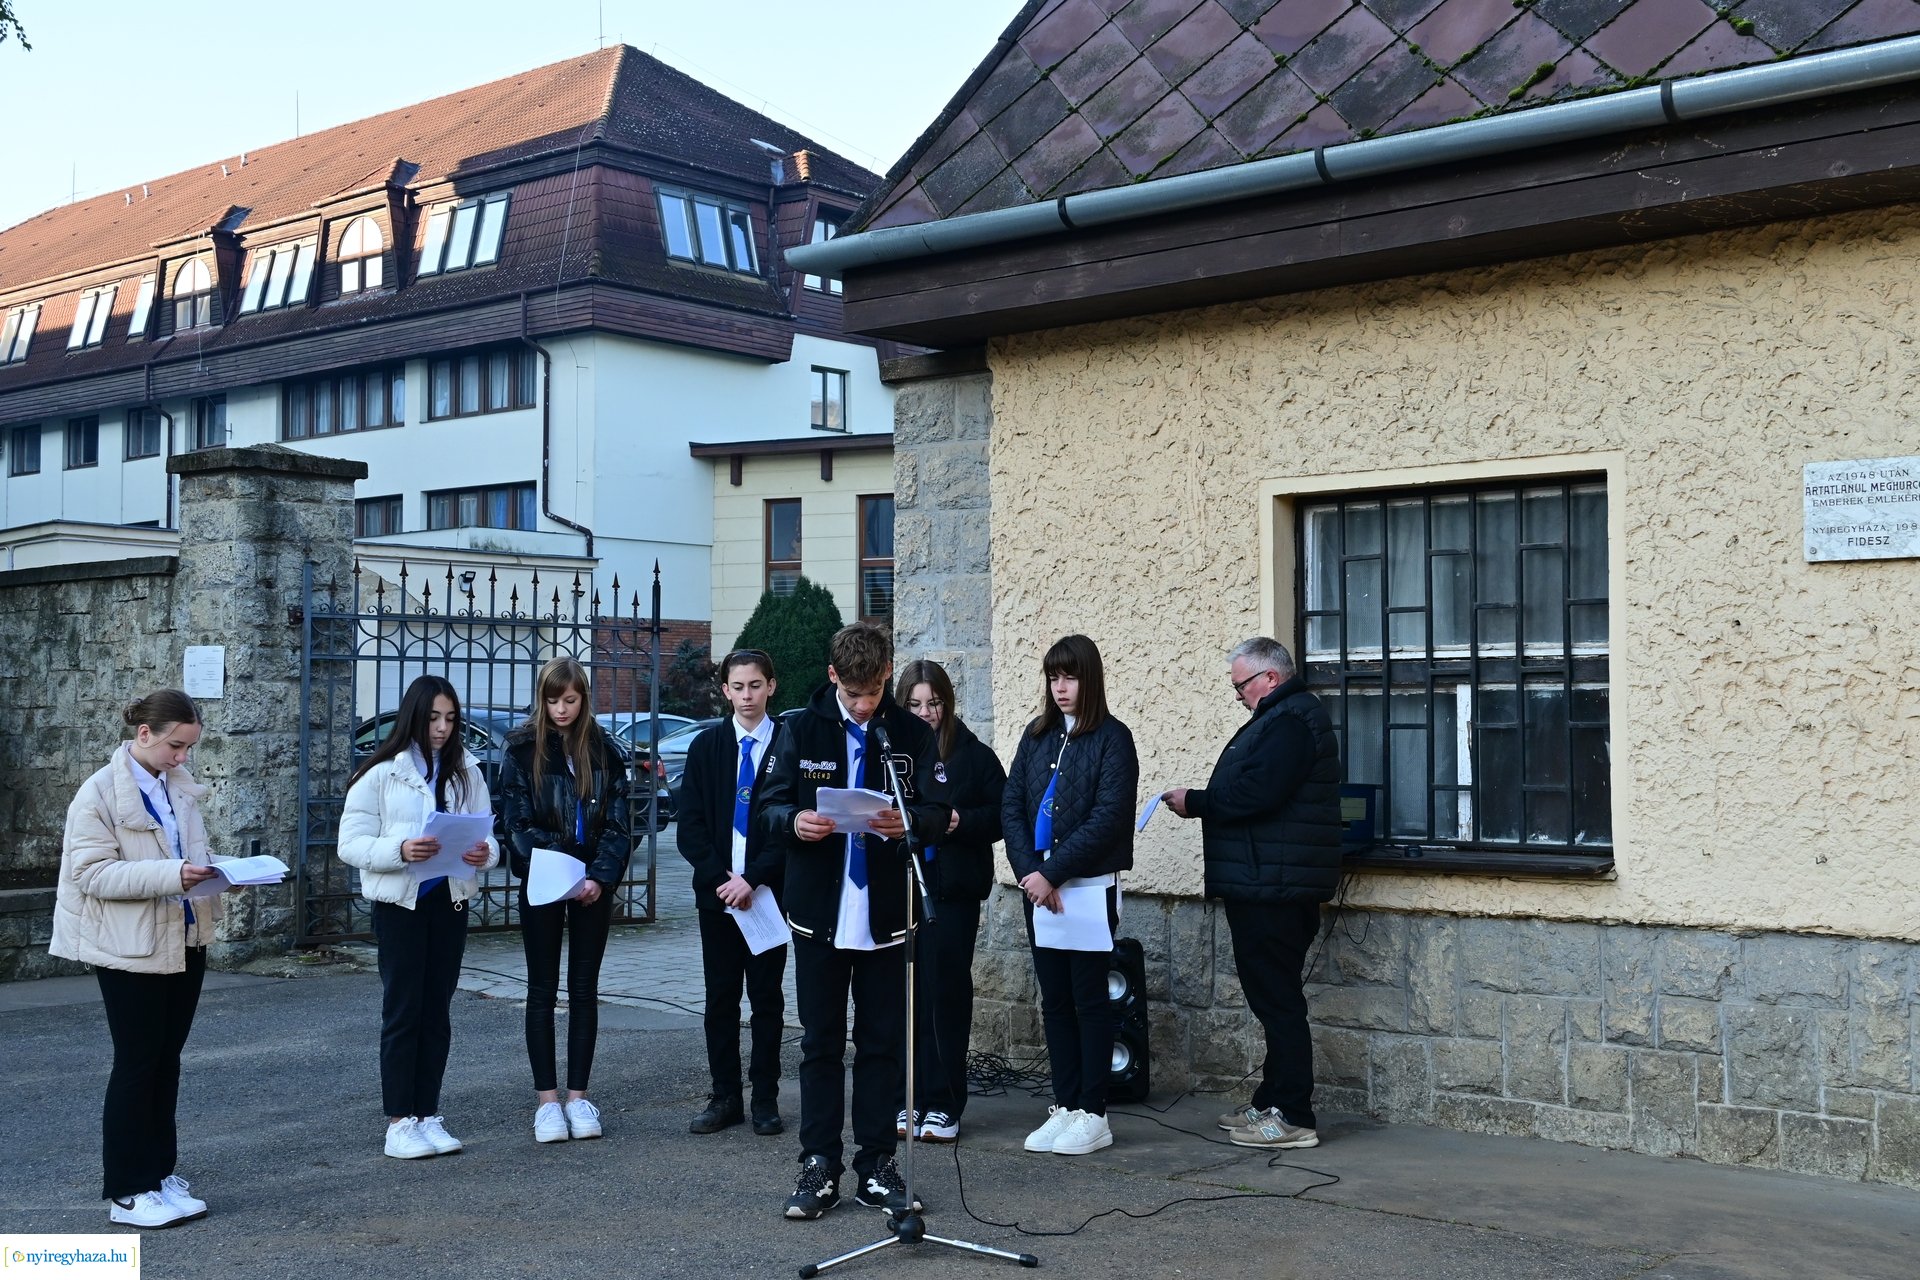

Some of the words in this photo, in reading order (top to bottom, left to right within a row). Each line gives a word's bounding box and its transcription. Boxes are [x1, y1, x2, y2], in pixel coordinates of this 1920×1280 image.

[1828, 473, 1841, 481] AZ
[1846, 471, 1876, 481] 1948
[1880, 466, 1910, 479] UTÁN
[1870, 480, 1920, 492] MEGHURC
[1812, 496, 1864, 507] EMBEREK
[1867, 491, 1920, 504] EMLÉKÉR
[1847, 535, 1890, 547] FIDESZ
[803, 771, 831, 780] LEGEND
[1260, 1123, 1283, 1141] N
